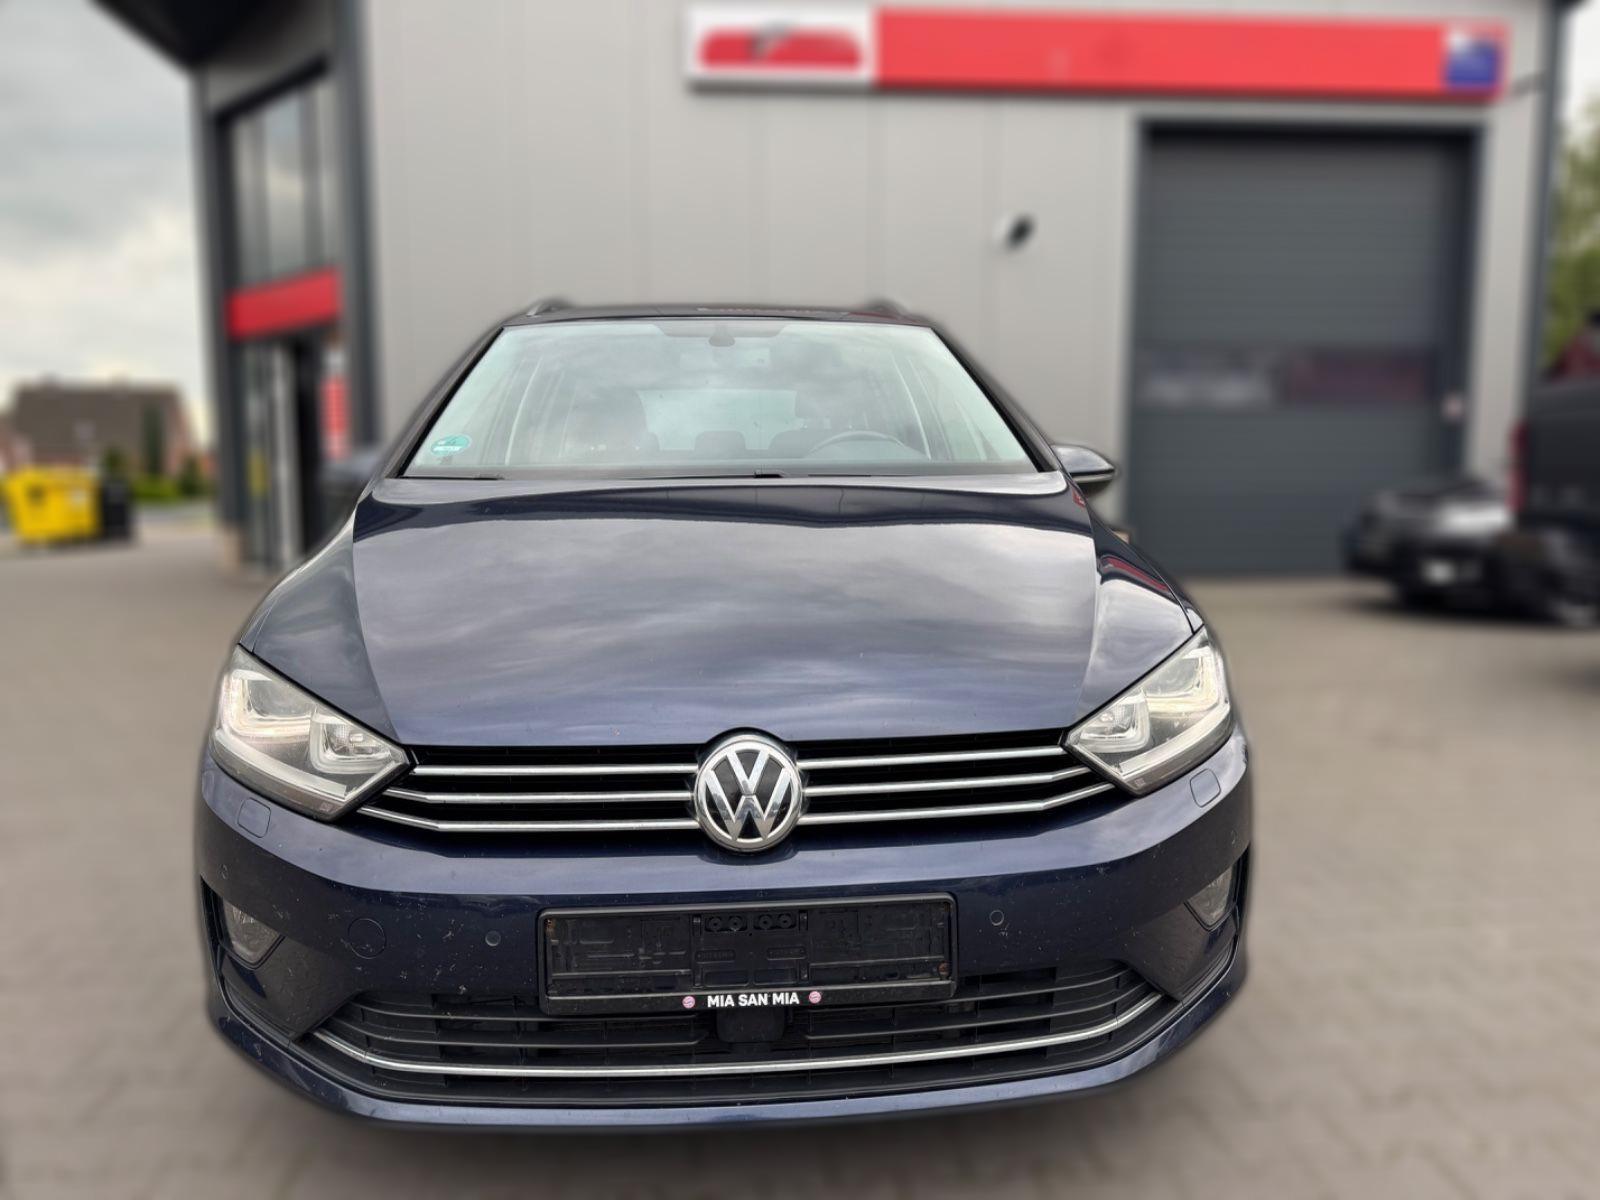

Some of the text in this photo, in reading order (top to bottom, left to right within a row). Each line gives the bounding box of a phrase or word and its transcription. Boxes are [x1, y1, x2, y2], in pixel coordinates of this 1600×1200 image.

[707, 994, 735, 1008] MIA
[738, 993, 769, 1007] SAN
[772, 991, 800, 1005] MIA
